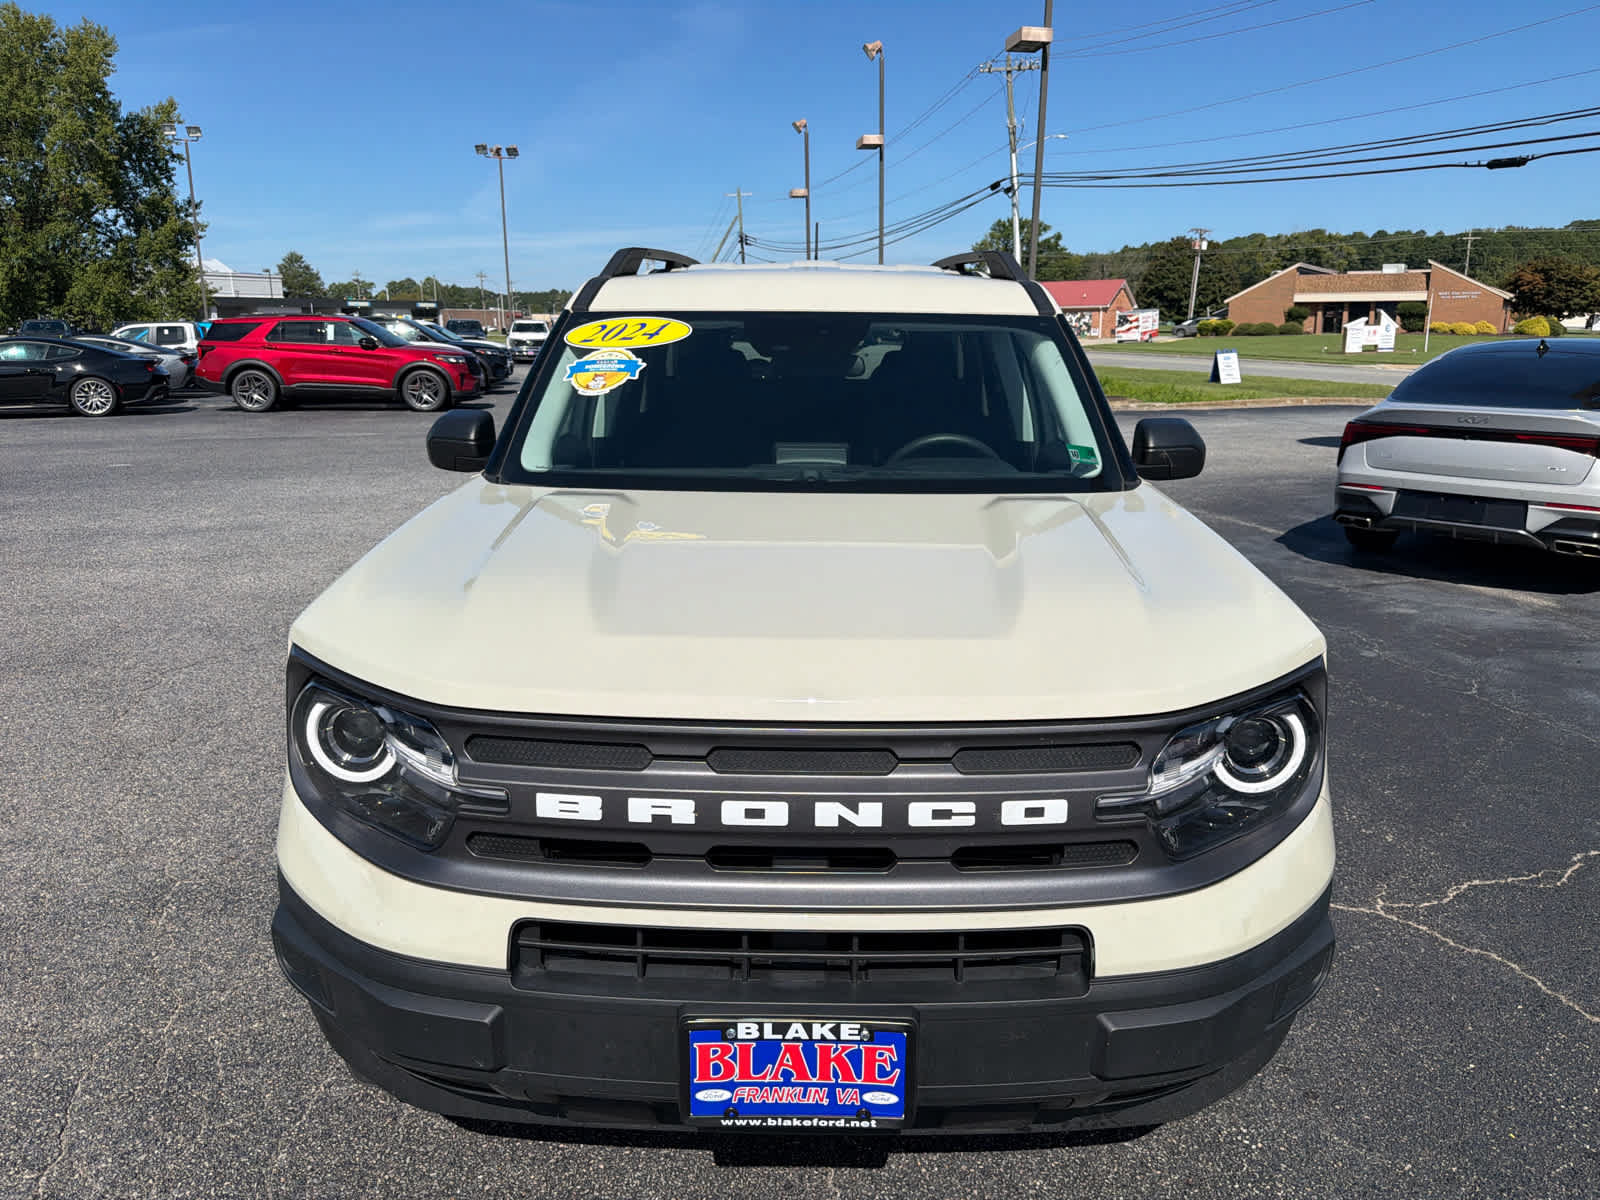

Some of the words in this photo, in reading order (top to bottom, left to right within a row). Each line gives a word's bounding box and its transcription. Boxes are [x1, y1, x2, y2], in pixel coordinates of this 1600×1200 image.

[579, 322, 671, 343] 2024
[535, 792, 1069, 827] BRONCO
[736, 1022, 861, 1040] BLAKE
[693, 1042, 900, 1086] BLAKE
[731, 1086, 830, 1106] FRANKLIN,
[836, 1088, 861, 1105] VA
[720, 1117, 877, 1128] www.blakeford.net
